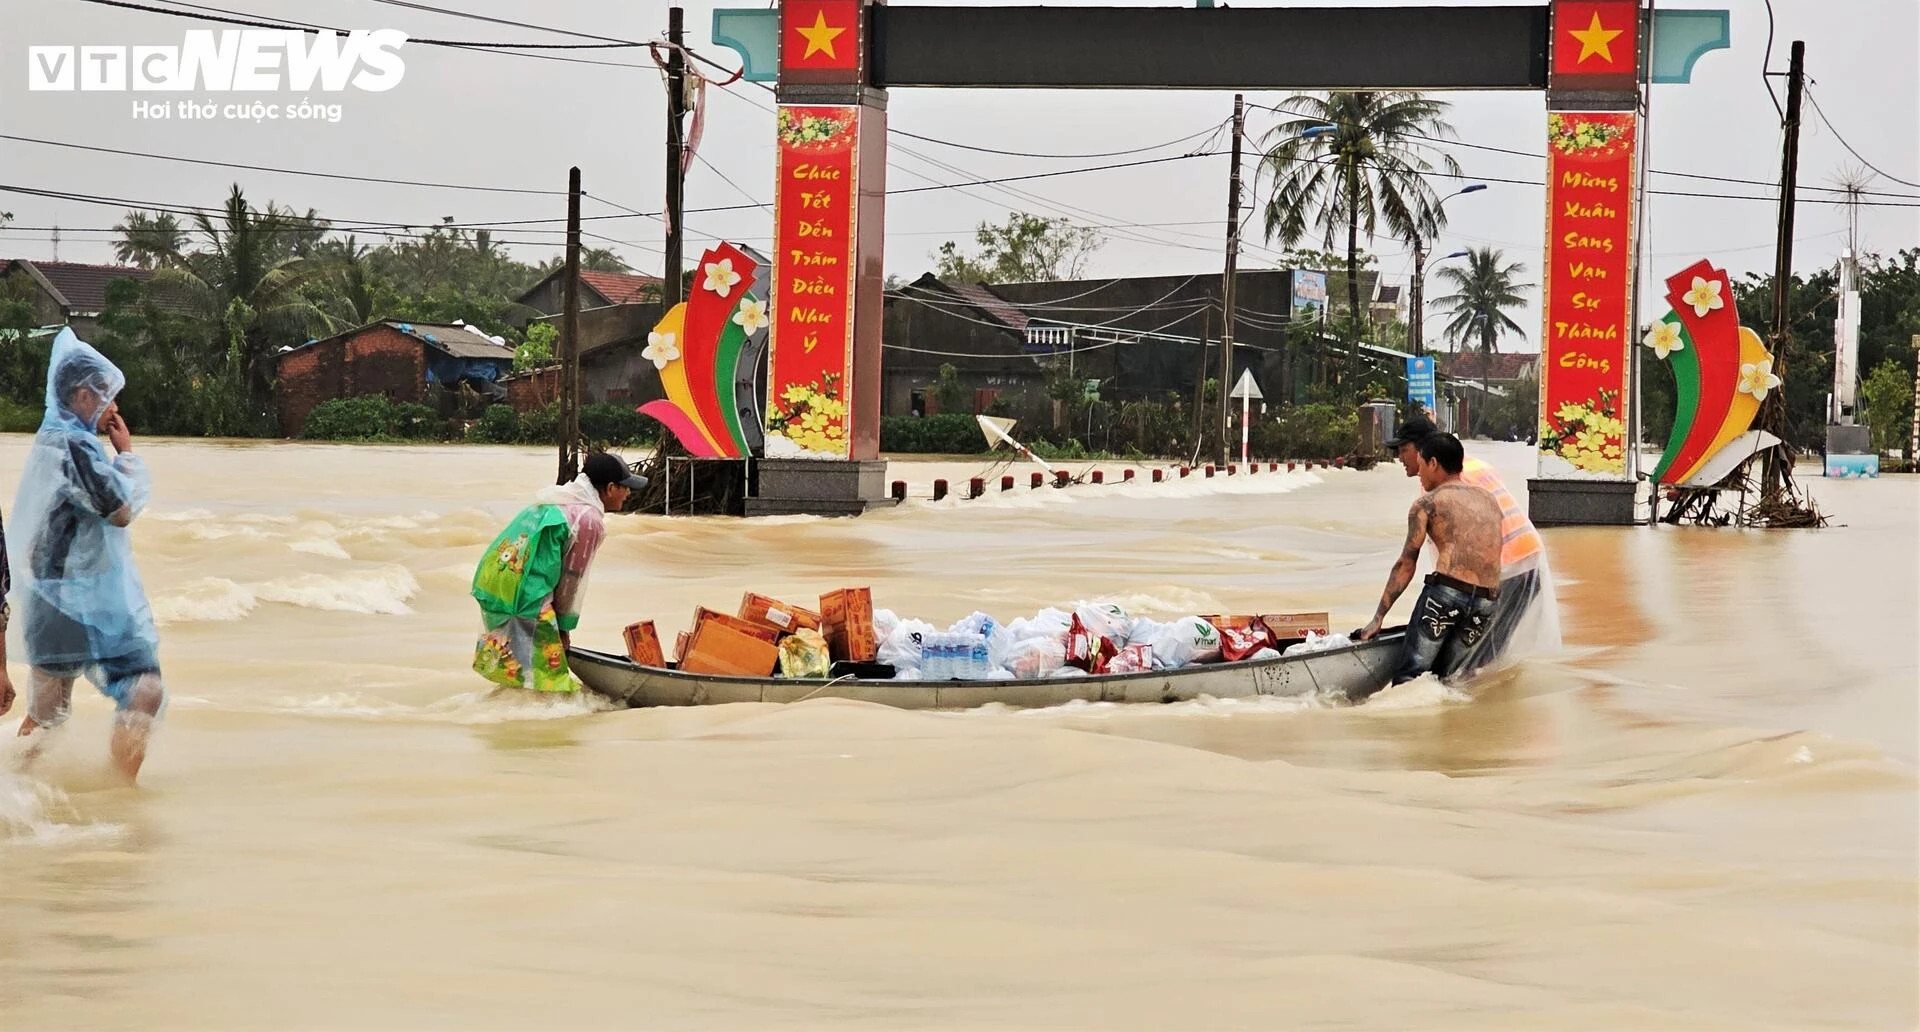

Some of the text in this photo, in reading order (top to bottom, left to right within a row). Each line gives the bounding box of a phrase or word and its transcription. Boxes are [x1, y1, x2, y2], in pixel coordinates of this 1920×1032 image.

[793, 163, 840, 180] Chúc
[1561, 170, 1618, 193] Mừng
[800, 190, 831, 209] Tết
[1564, 201, 1616, 218] Xuân
[798, 218, 833, 238] Đến
[1564, 231, 1613, 253] Sang
[791, 249, 837, 266] Trăm
[1569, 262, 1607, 282] Vạn
[792, 275, 834, 295] Điều
[1572, 292, 1601, 312] Sự
[790, 306, 832, 324] Như
[1555, 321, 1617, 340] Thành
[1559, 351, 1610, 374] Công
